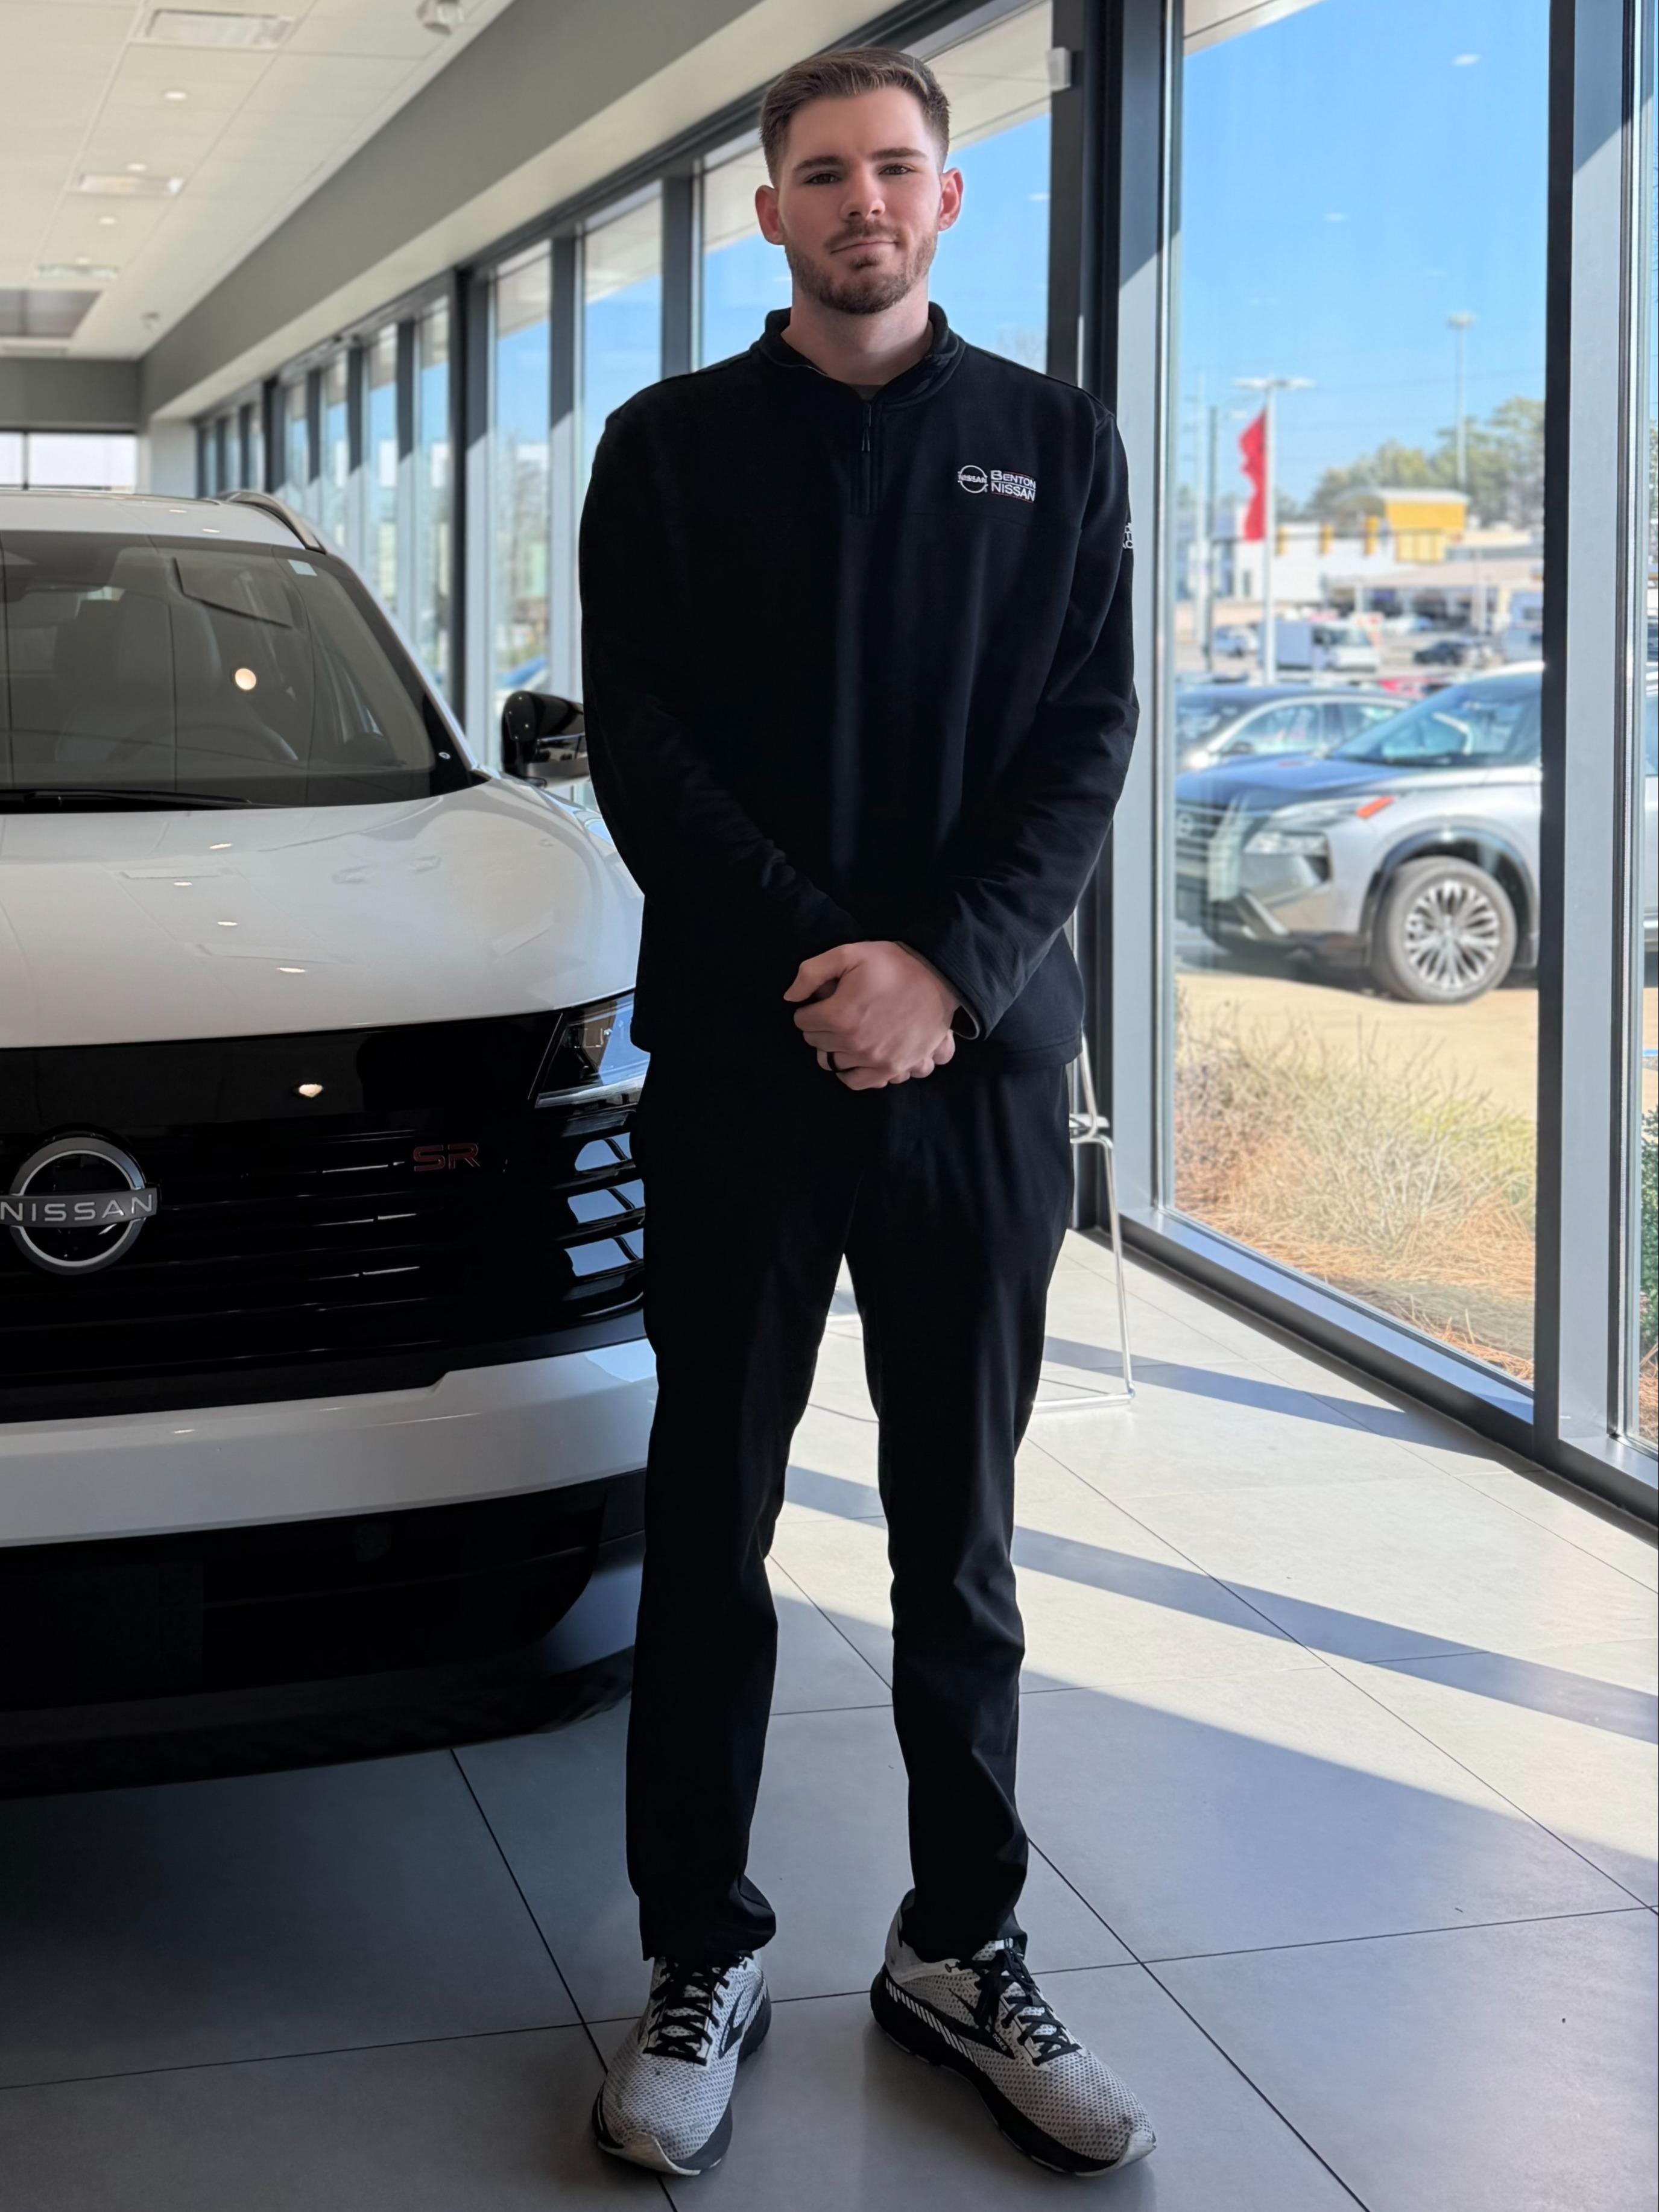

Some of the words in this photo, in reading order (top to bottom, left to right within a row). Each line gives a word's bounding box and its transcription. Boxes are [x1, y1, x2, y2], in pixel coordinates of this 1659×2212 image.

[958, 474, 987, 484] NISSAN
[991, 482, 1035, 502] NISSAN
[413, 1143, 481, 1172] SR
[0, 1195, 153, 1222] NISSAN
